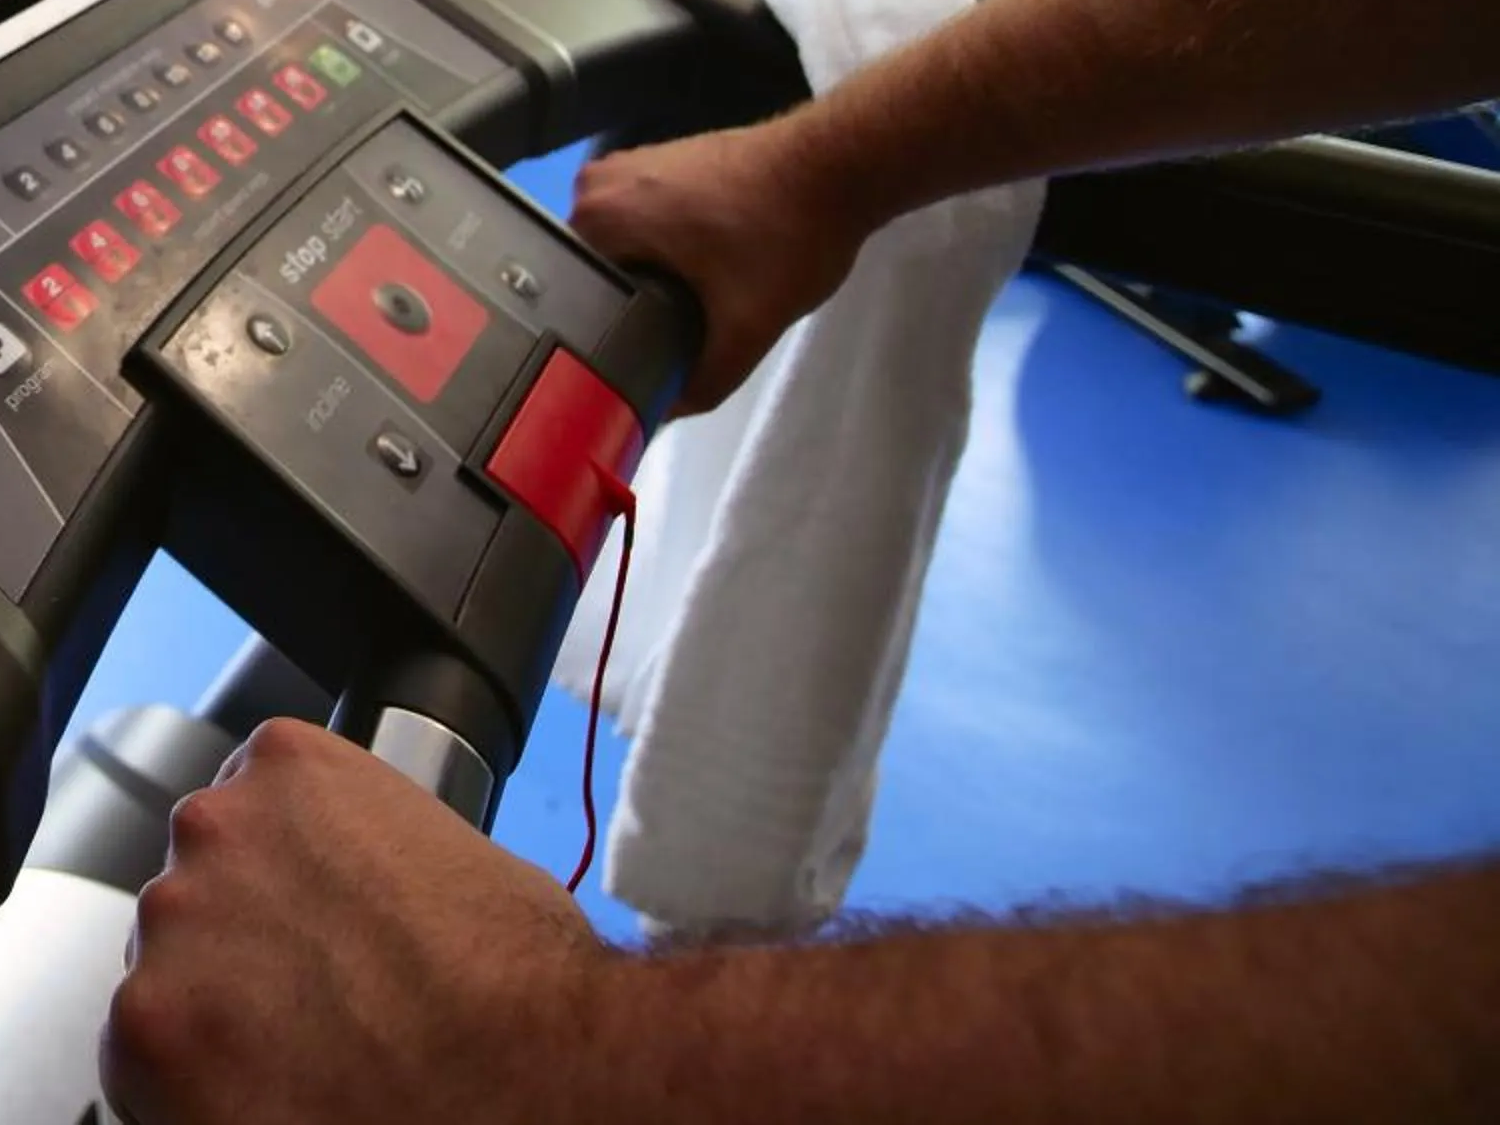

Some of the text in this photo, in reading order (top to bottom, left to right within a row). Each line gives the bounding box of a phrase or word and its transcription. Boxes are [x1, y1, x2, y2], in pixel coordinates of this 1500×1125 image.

[19, 172, 40, 192] 2
[90, 230, 107, 248] 4
[278, 235, 328, 285] stop
[41, 276, 64, 297] 2
